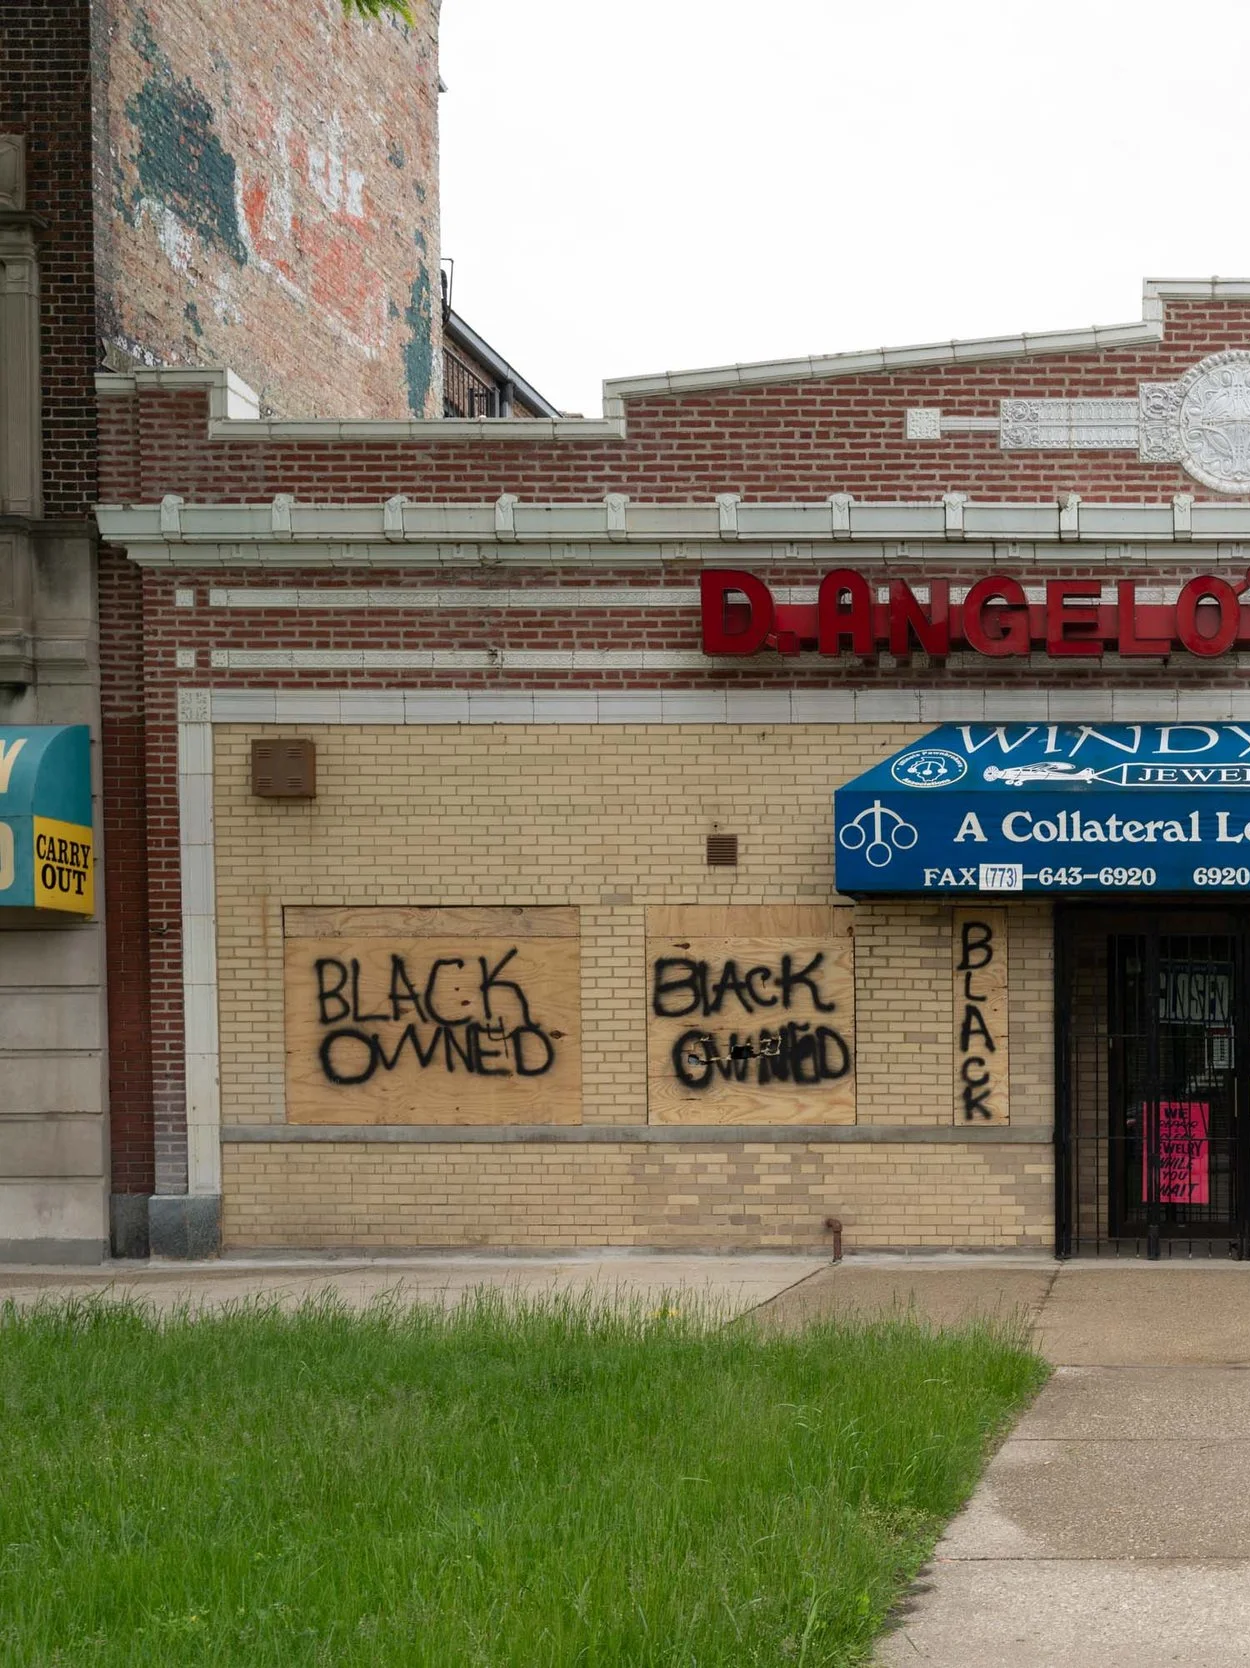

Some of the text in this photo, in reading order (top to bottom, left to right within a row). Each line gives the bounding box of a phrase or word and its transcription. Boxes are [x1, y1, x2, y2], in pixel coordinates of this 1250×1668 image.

[953, 812, 988, 842] A
[1002, 811, 1202, 842] Collateral
[36, 834, 91, 869] CARRY
[41, 864, 86, 895] OUT
[923, 868, 977, 886] FAX
[1193, 867, 1250, 886] 6920
[315, 947, 541, 1028] BLACK
[956, 921, 996, 1121] BLACK
[320, 1022, 555, 1085] OWNED
[672, 1021, 850, 1088] OWNED
[1163, 1171, 1188, 1181] YOU
